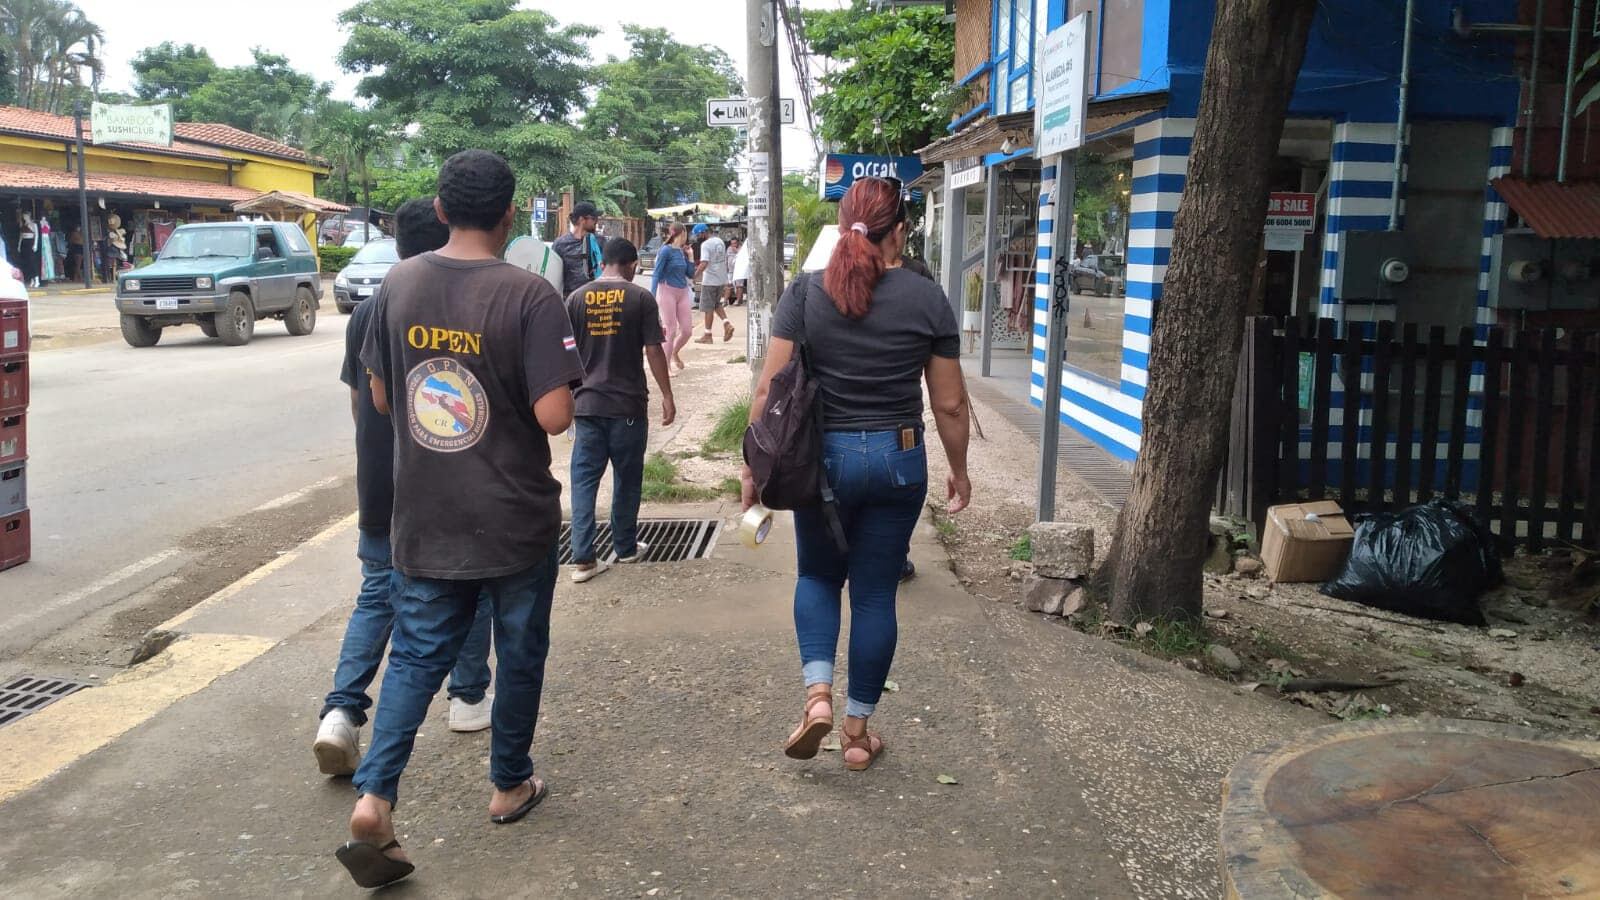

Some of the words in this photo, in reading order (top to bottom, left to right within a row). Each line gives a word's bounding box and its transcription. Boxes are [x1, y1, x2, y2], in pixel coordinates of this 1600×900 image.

[784, 104, 790, 116] 2
[1267, 199, 1281, 211] OR
[1283, 199, 1308, 211] SALE
[585, 289, 625, 305] OPEN
[407, 325, 482, 355] OPEN
[434, 418, 448, 428] CR
